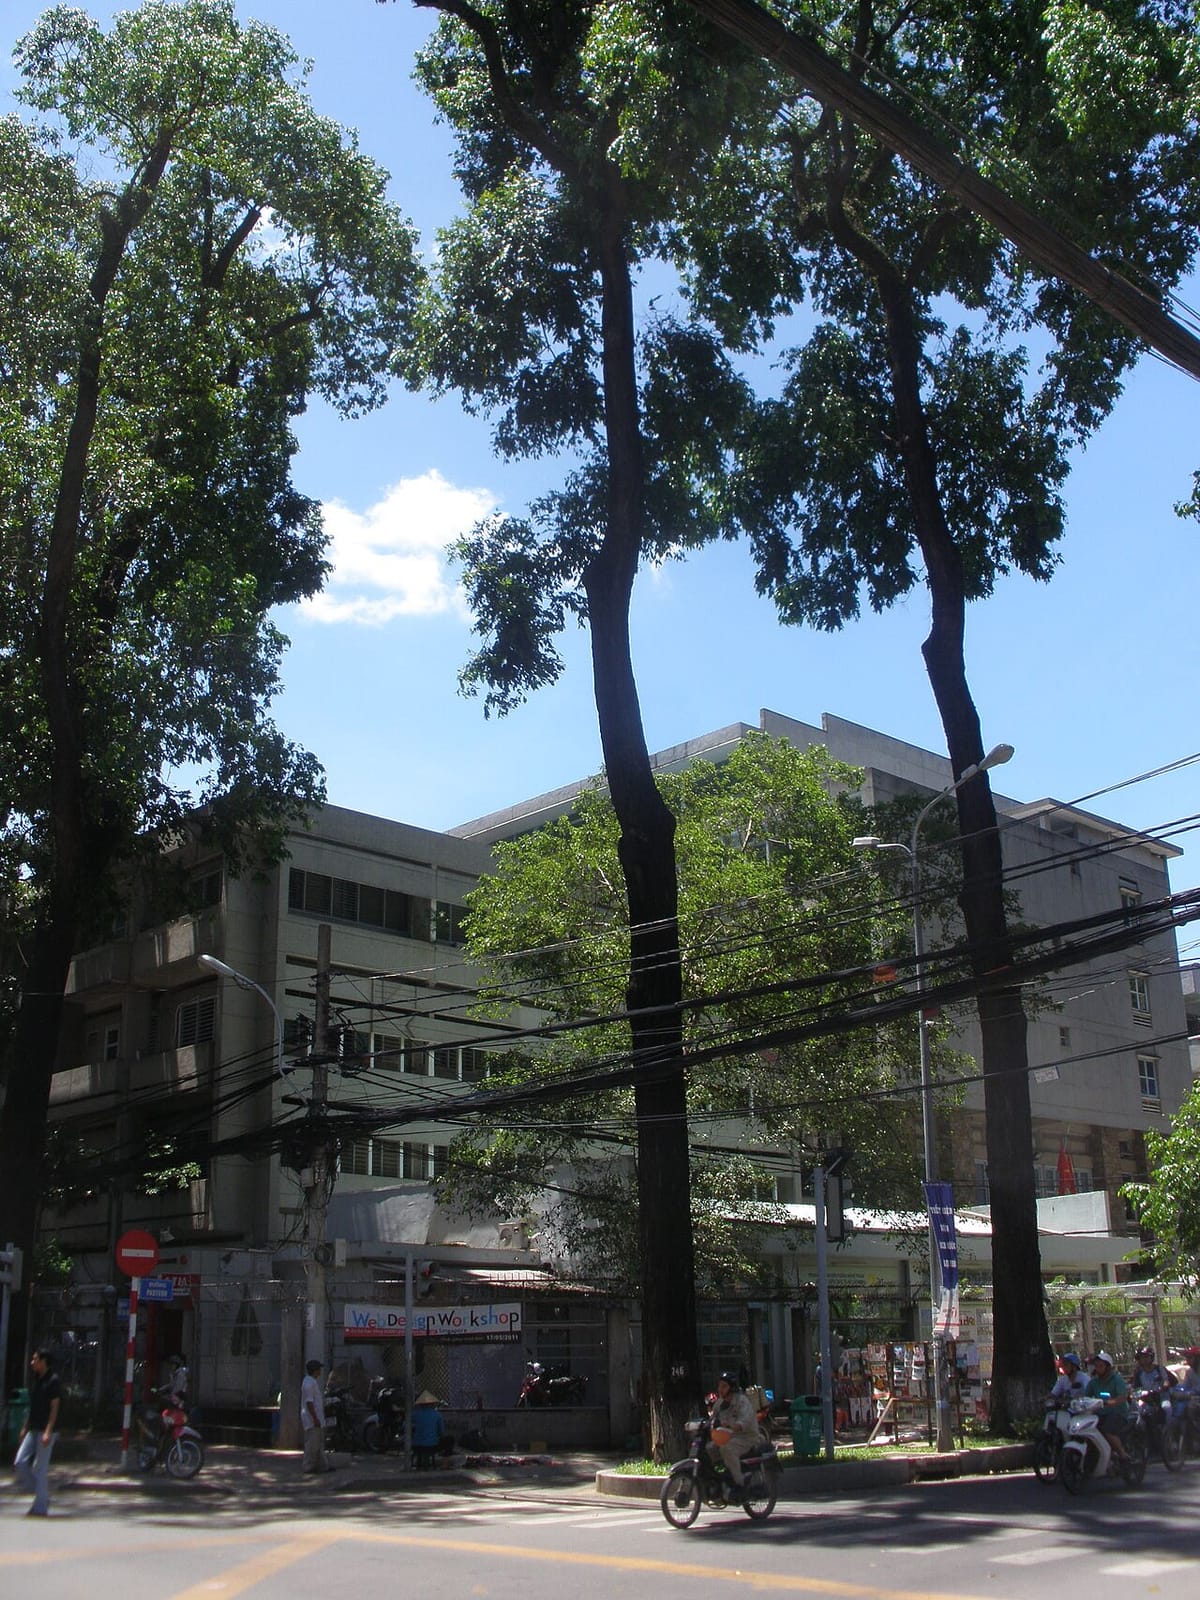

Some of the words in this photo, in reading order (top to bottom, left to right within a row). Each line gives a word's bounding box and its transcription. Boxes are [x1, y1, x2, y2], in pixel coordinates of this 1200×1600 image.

[352, 1310, 387, 1329] Web
[388, 1313, 435, 1335] Deign
[438, 1304, 520, 1332] Workshop
